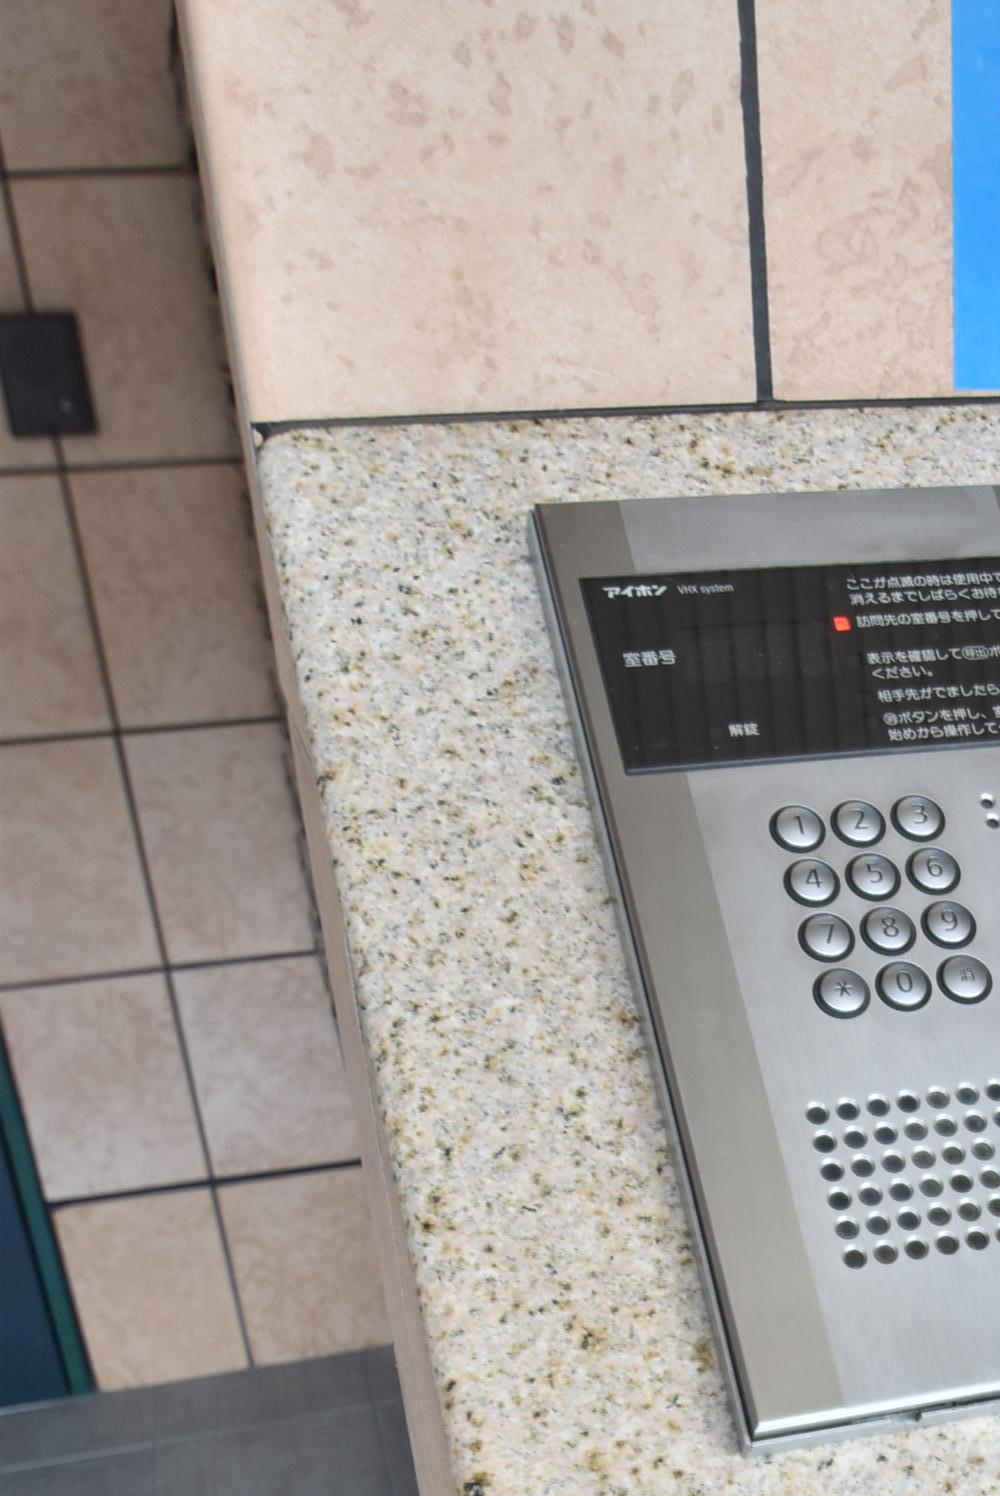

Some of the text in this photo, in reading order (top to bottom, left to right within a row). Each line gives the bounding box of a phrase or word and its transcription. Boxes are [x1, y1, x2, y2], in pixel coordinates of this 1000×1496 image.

[603, 584, 668, 599] アイホン
[700, 583, 735, 596] system
[622, 649, 676, 668] 室番号
[872, 665, 934, 680] ください。
[728, 722, 760, 738] 解錠
[853, 810, 869, 830] 2
[913, 805, 928, 824] 3
[792, 815, 805, 835] 1
[866, 863, 883, 883] 5
[926, 858, 943, 877] 6
[805, 868, 823, 889] 4
[881, 917, 899, 937] 8
[941, 910, 958, 931] 9
[818, 923, 835, 944] 7
[896, 970, 913, 992] 0
